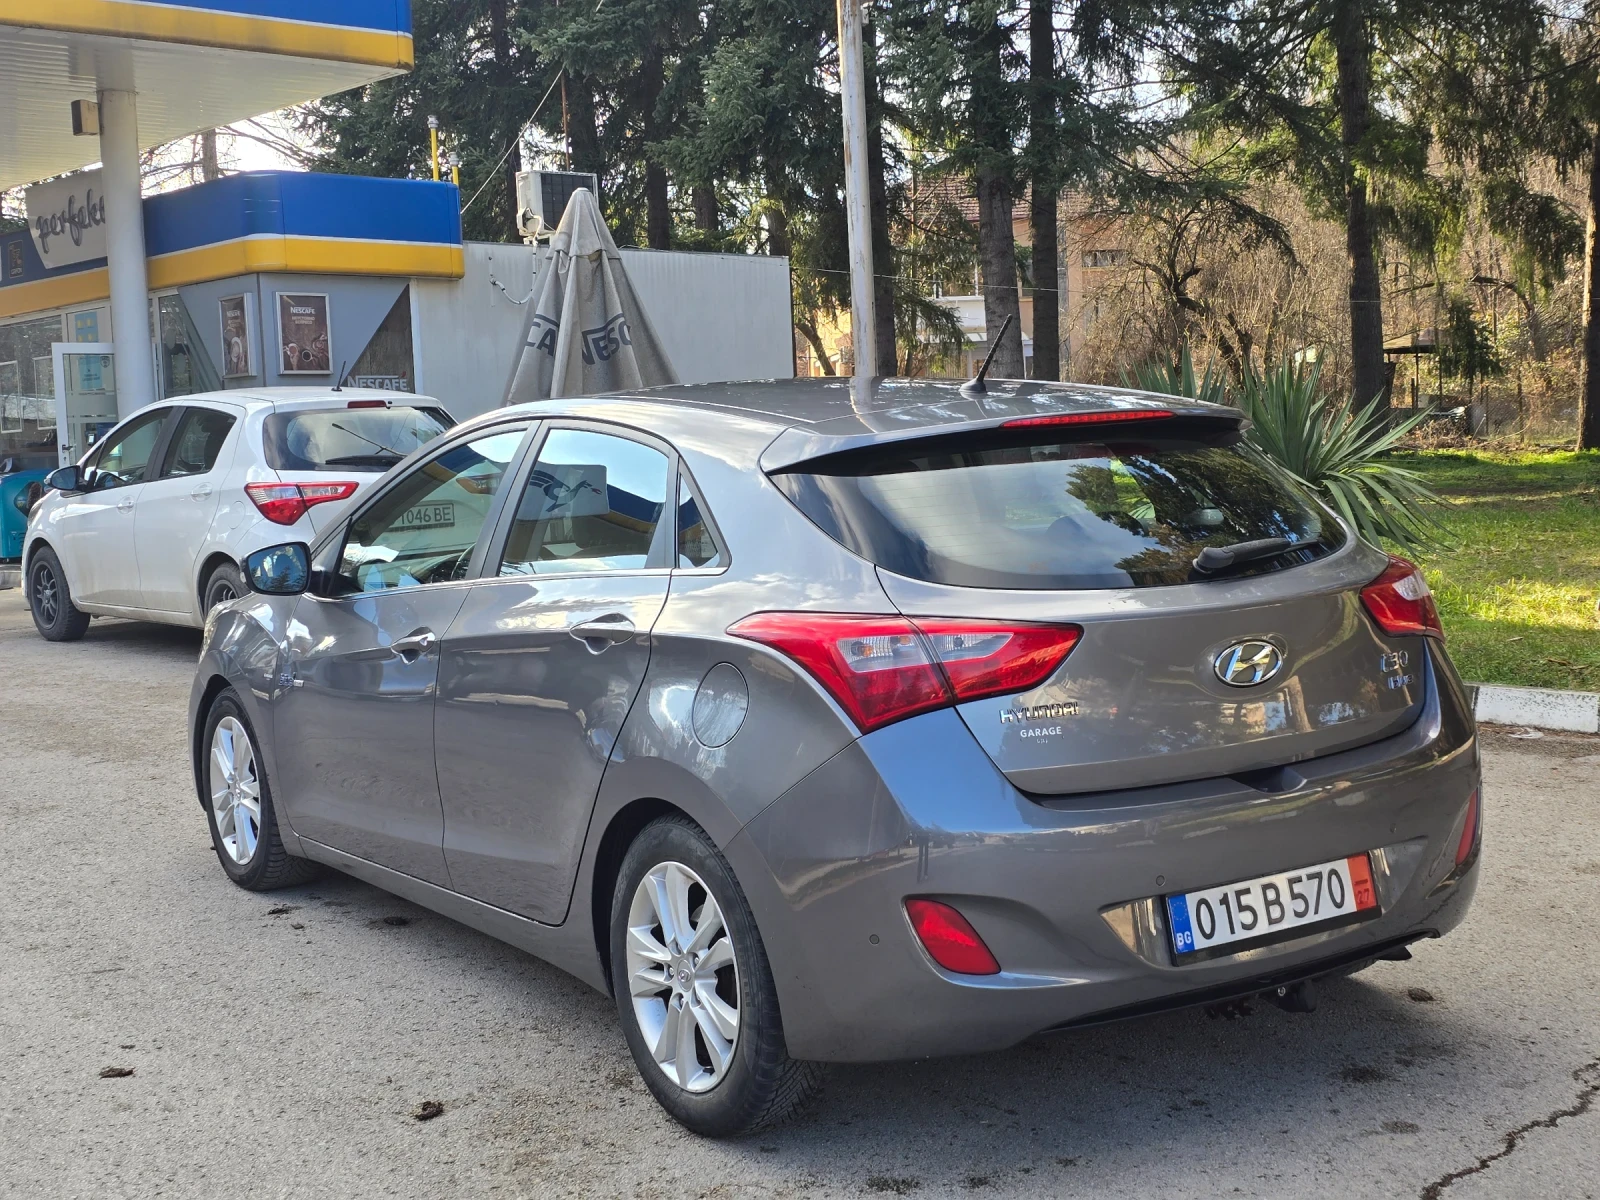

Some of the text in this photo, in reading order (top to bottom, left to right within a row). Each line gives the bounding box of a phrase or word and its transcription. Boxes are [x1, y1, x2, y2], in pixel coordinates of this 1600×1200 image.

[999, 702, 1079, 724] HYUNDAI
[1020, 727, 1062, 738] GARAGE
[1176, 931, 1192, 946] BG
